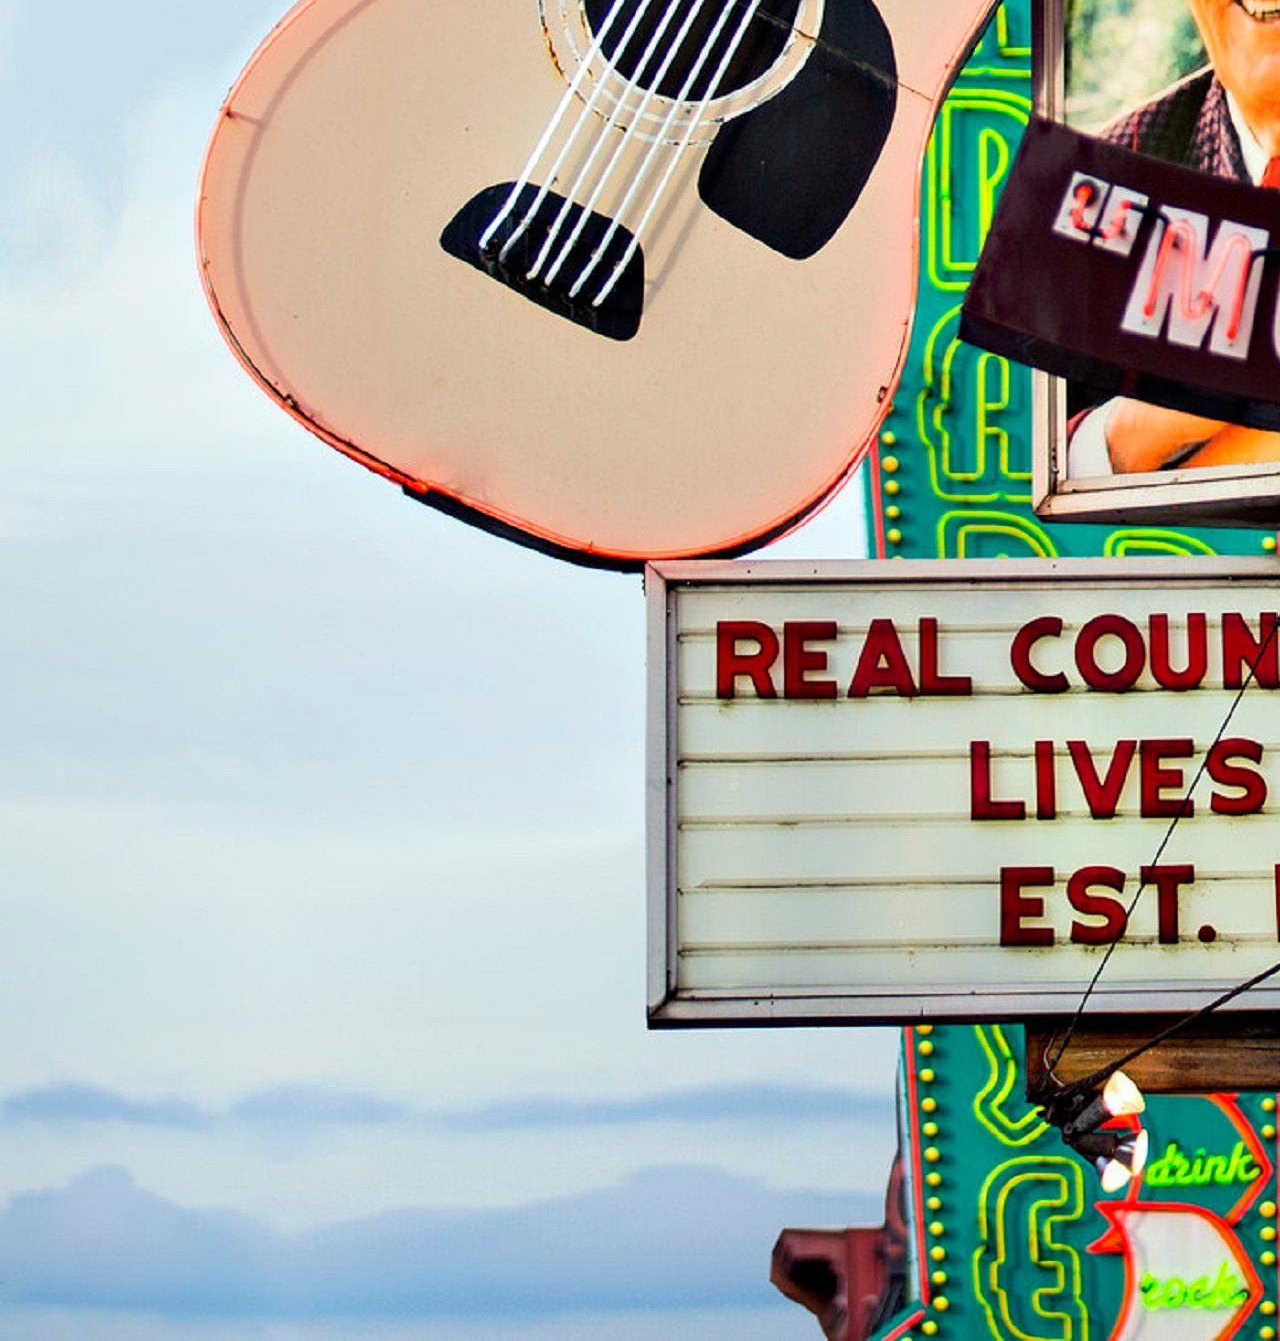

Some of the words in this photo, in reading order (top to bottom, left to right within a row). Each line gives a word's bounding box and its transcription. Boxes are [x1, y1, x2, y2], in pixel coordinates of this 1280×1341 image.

[716, 618, 973, 700] REAL
[970, 738, 1267, 821] LIVES
[1000, 865, 1217, 946] EST.
[1145, 1140, 1261, 1187] drink
[1141, 1260, 1248, 1310] rock
